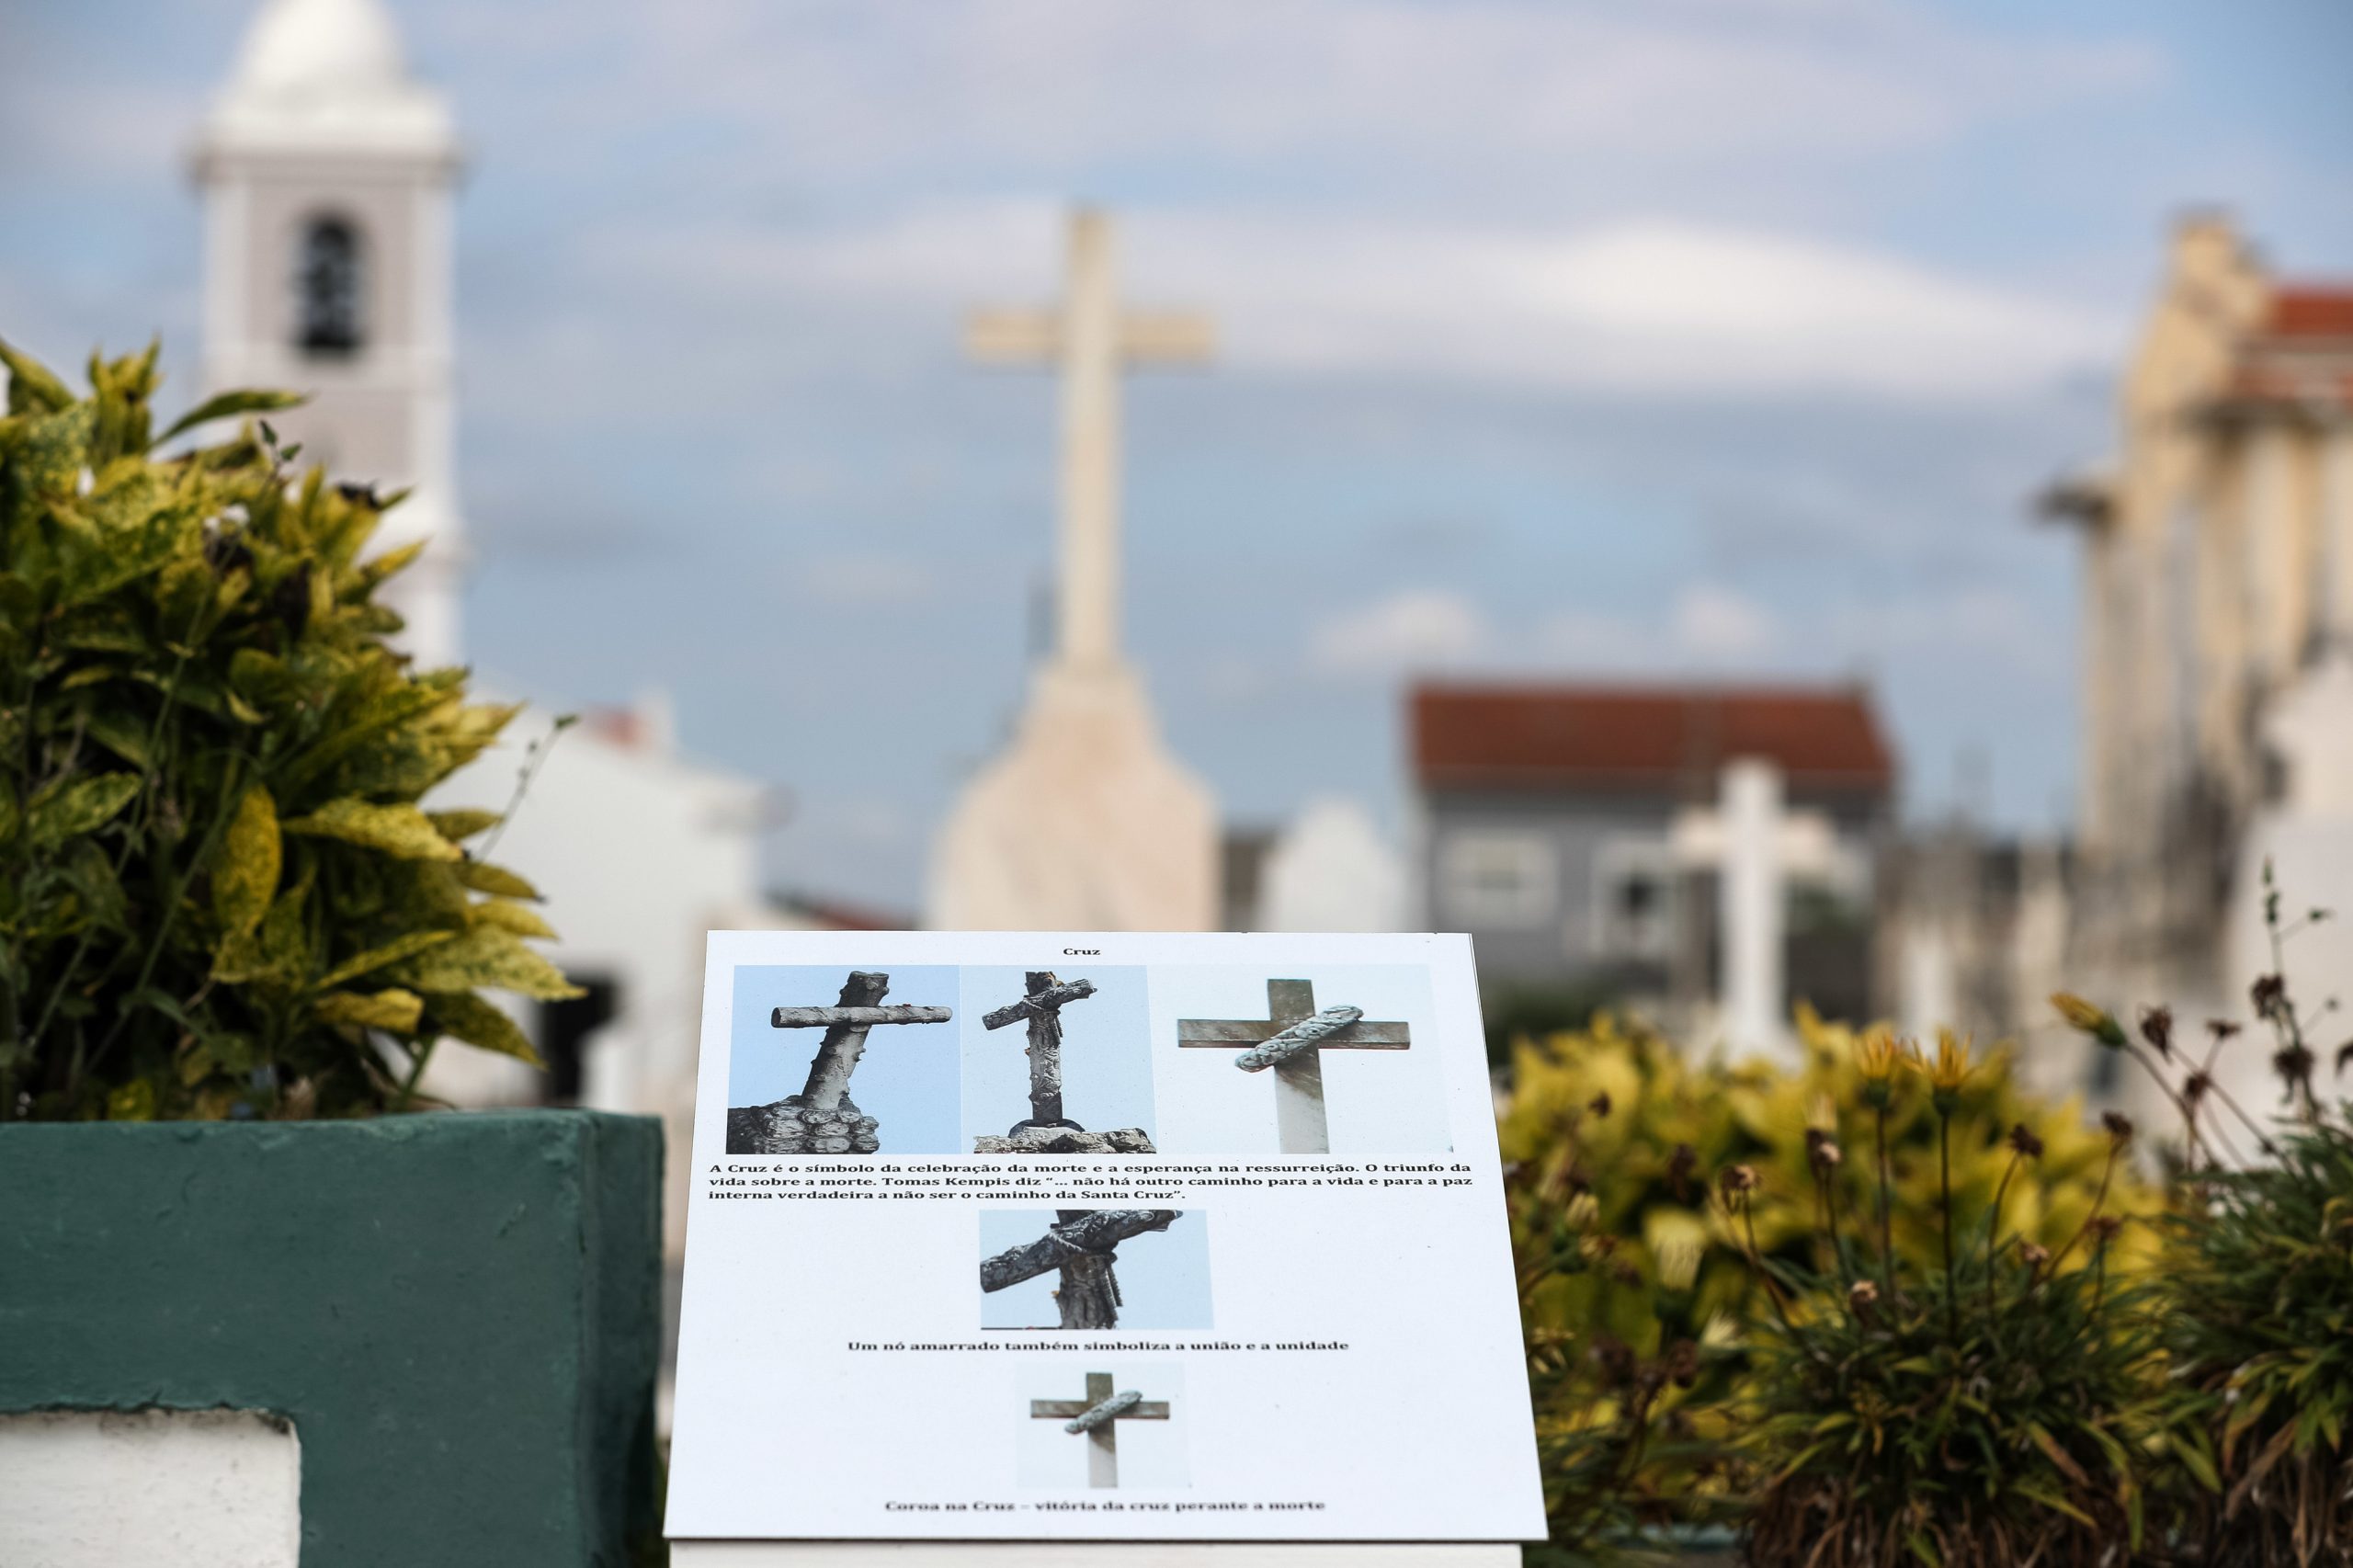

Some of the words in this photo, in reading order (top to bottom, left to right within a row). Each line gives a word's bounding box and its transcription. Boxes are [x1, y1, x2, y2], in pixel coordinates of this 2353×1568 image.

[1063, 948, 1101, 956] Cruz
[709, 1165, 722, 1173] A
[727, 1164, 767, 1173] Cruz
[772, 1164, 784, 1173] é
[804, 1164, 875, 1173] símbolo
[880, 1164, 902, 1173] da
[907, 1164, 1002, 1175] celebração
[1006, 1164, 1029, 1173] da
[1034, 1165, 1087, 1173] morte
[1123, 1165, 1212, 1175] esperança
[1245, 1164, 1360, 1175] ressurreição.
[1365, 1164, 1379, 1173] O
[1383, 1163, 1445, 1173] triunfo
[1449, 1163, 1472, 1172] da
[709, 1177, 746, 1187] vida
[750, 1177, 801, 1187] sobre
[820, 1177, 877, 1187] morte.
[881, 1177, 940, 1187] Tomas
[945, 1177, 1011, 1188] Kempis
[1015, 1176, 1042, 1186] diz
[1073, 1176, 1105, 1186] não
[1108, 1176, 1131, 1186] há
[1135, 1177, 1184, 1186] outro
[1188, 1176, 1263, 1186] caminho
[1267, 1178, 1308, 1188] para
[1326, 1176, 1364, 1186] vida
[1382, 1178, 1424, 1187] para
[1441, 1178, 1473, 1187] paz
[708, 1190, 773, 1199] interna
[777, 1190, 874, 1199] verdadeira
[892, 1190, 926, 1199] não
[975, 1190, 1051, 1199] caminho
[1055, 1190, 1077, 1199] da
[1080, 1190, 1130, 1199] Santa
[847, 1341, 878, 1351] Um
[882, 1341, 906, 1351] nó
[909, 1341, 1001, 1351] amarrado
[1005, 1341, 1079, 1351] também
[1083, 1341, 1171, 1351] simboliza
[1175, 1343, 1186, 1351] a
[1190, 1341, 1242, 1351] união
[1245, 1343, 1256, 1351] e
[1260, 1343, 1271, 1351] a
[1275, 1340, 1349, 1351] unidade
[884, 1500, 941, 1513] Coroa
[944, 1503, 969, 1512] na
[972, 1500, 1016, 1512] Cruz
[1034, 1500, 1098, 1512] vitória
[1101, 1500, 1126, 1512] da
[1129, 1502, 1171, 1512] cruz
[1174, 1501, 1249, 1515] perante
[1252, 1502, 1265, 1512] a
[1267, 1500, 1326, 1512] morte
